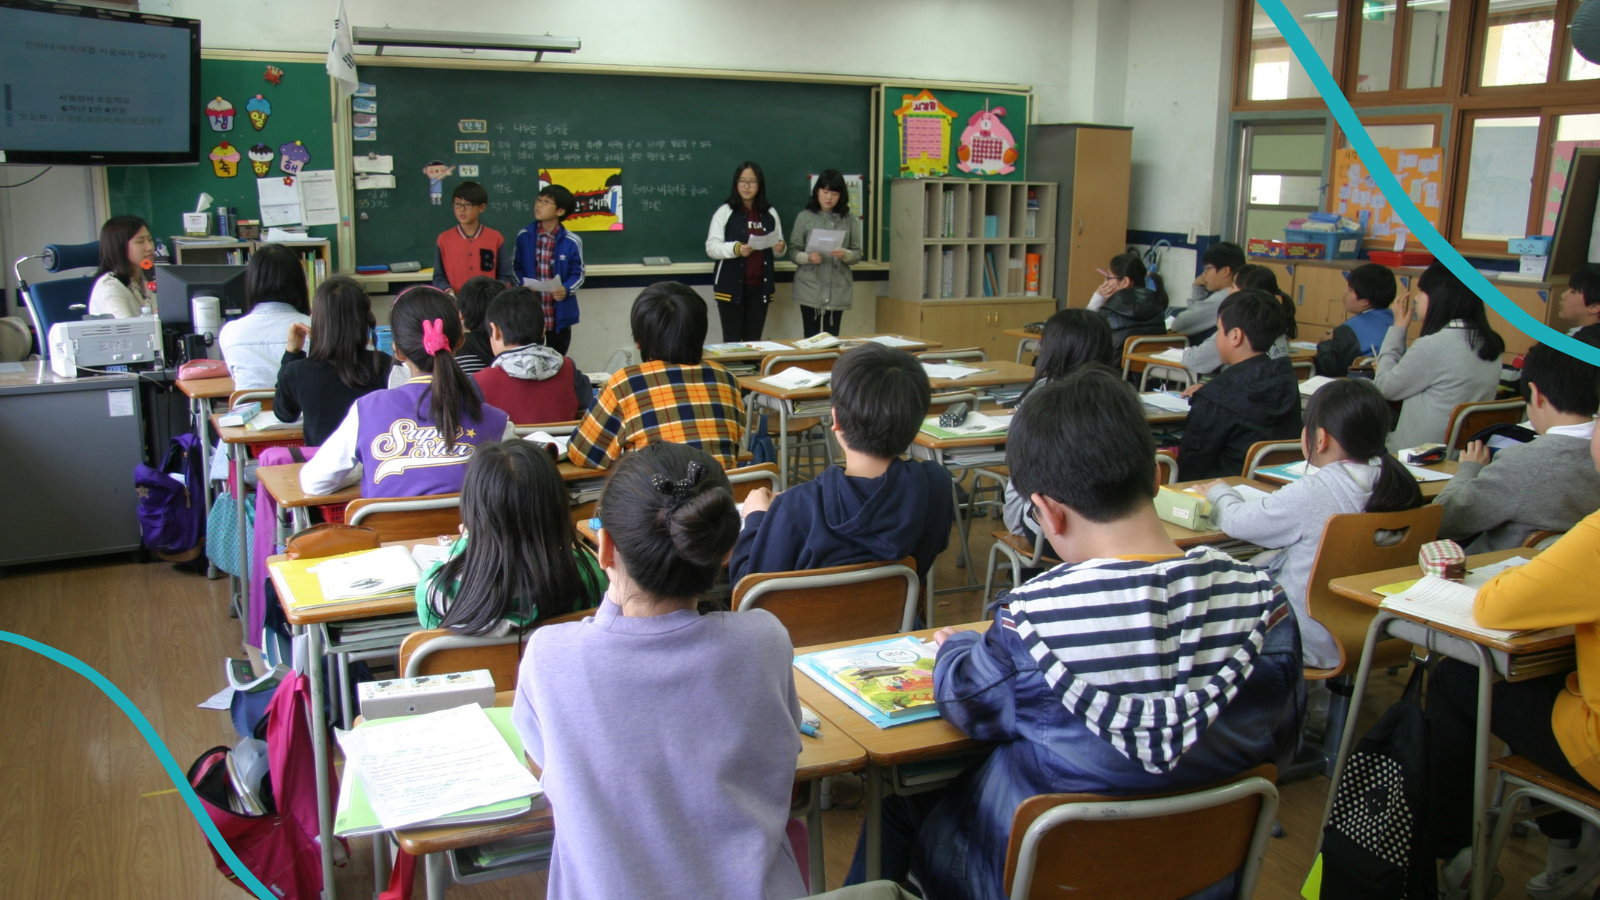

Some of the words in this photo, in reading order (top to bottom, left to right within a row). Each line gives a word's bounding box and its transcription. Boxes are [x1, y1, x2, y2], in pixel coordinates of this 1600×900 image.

[514, 123, 538, 135] 나누는
[545, 123, 569, 135] 즐거움
[254, 162, 269, 173] 하
[284, 160, 298, 173] 해
[480, 248, 495, 271] B
[371, 419, 464, 460] Sup
